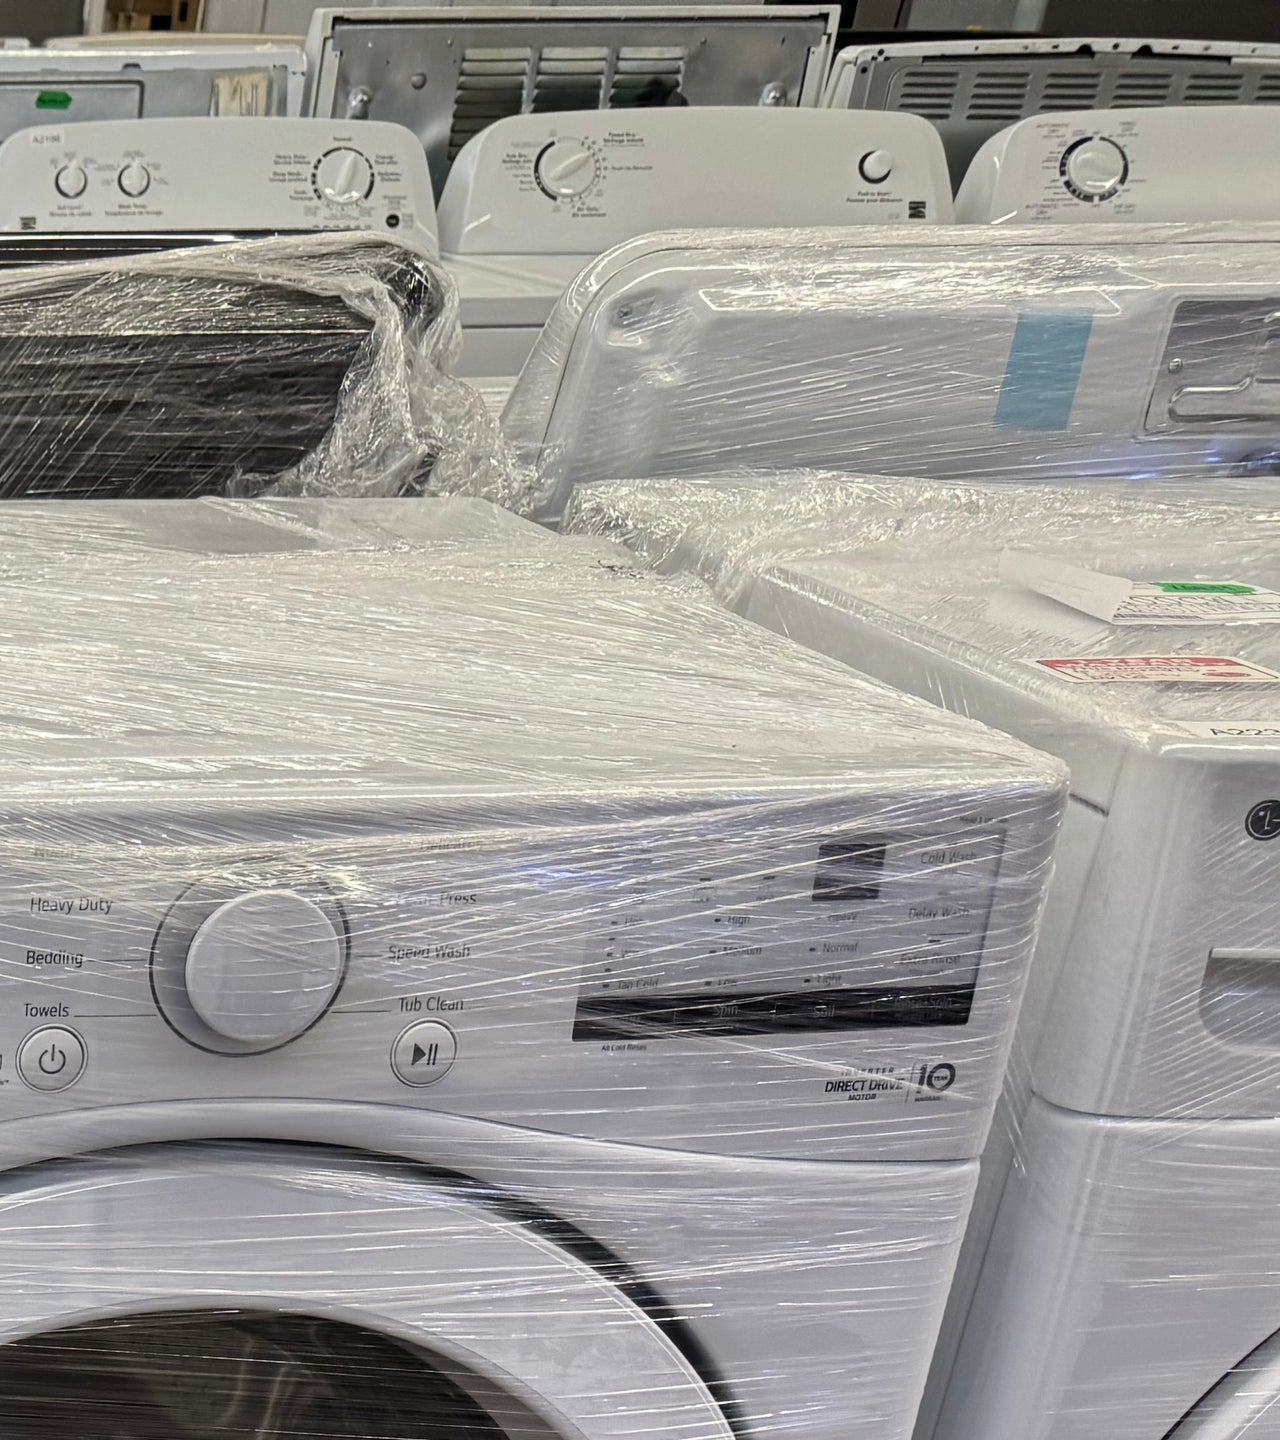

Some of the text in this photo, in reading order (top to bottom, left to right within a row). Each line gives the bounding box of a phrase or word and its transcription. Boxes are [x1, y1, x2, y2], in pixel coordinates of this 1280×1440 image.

[920, 850, 977, 865] Cold Wash
[439, 891, 477, 905] Press
[30, 897, 113, 915] Heavy Duty
[908, 907, 970, 919] Delay Wash
[727, 915, 750, 927] High
[388, 944, 471, 960] Speed Wash
[823, 943, 858, 952] Normal
[26, 950, 83, 968] Bedding
[817, 974, 842, 986] Light
[24, 1002, 70, 1017] Towels
[399, 996, 464, 1012] Tub Clean
[713, 1005, 739, 1019] Spin
[825, 1080, 903, 1092] DIRECT DRIVE
[848, 1093, 877, 1101] MOTOR
